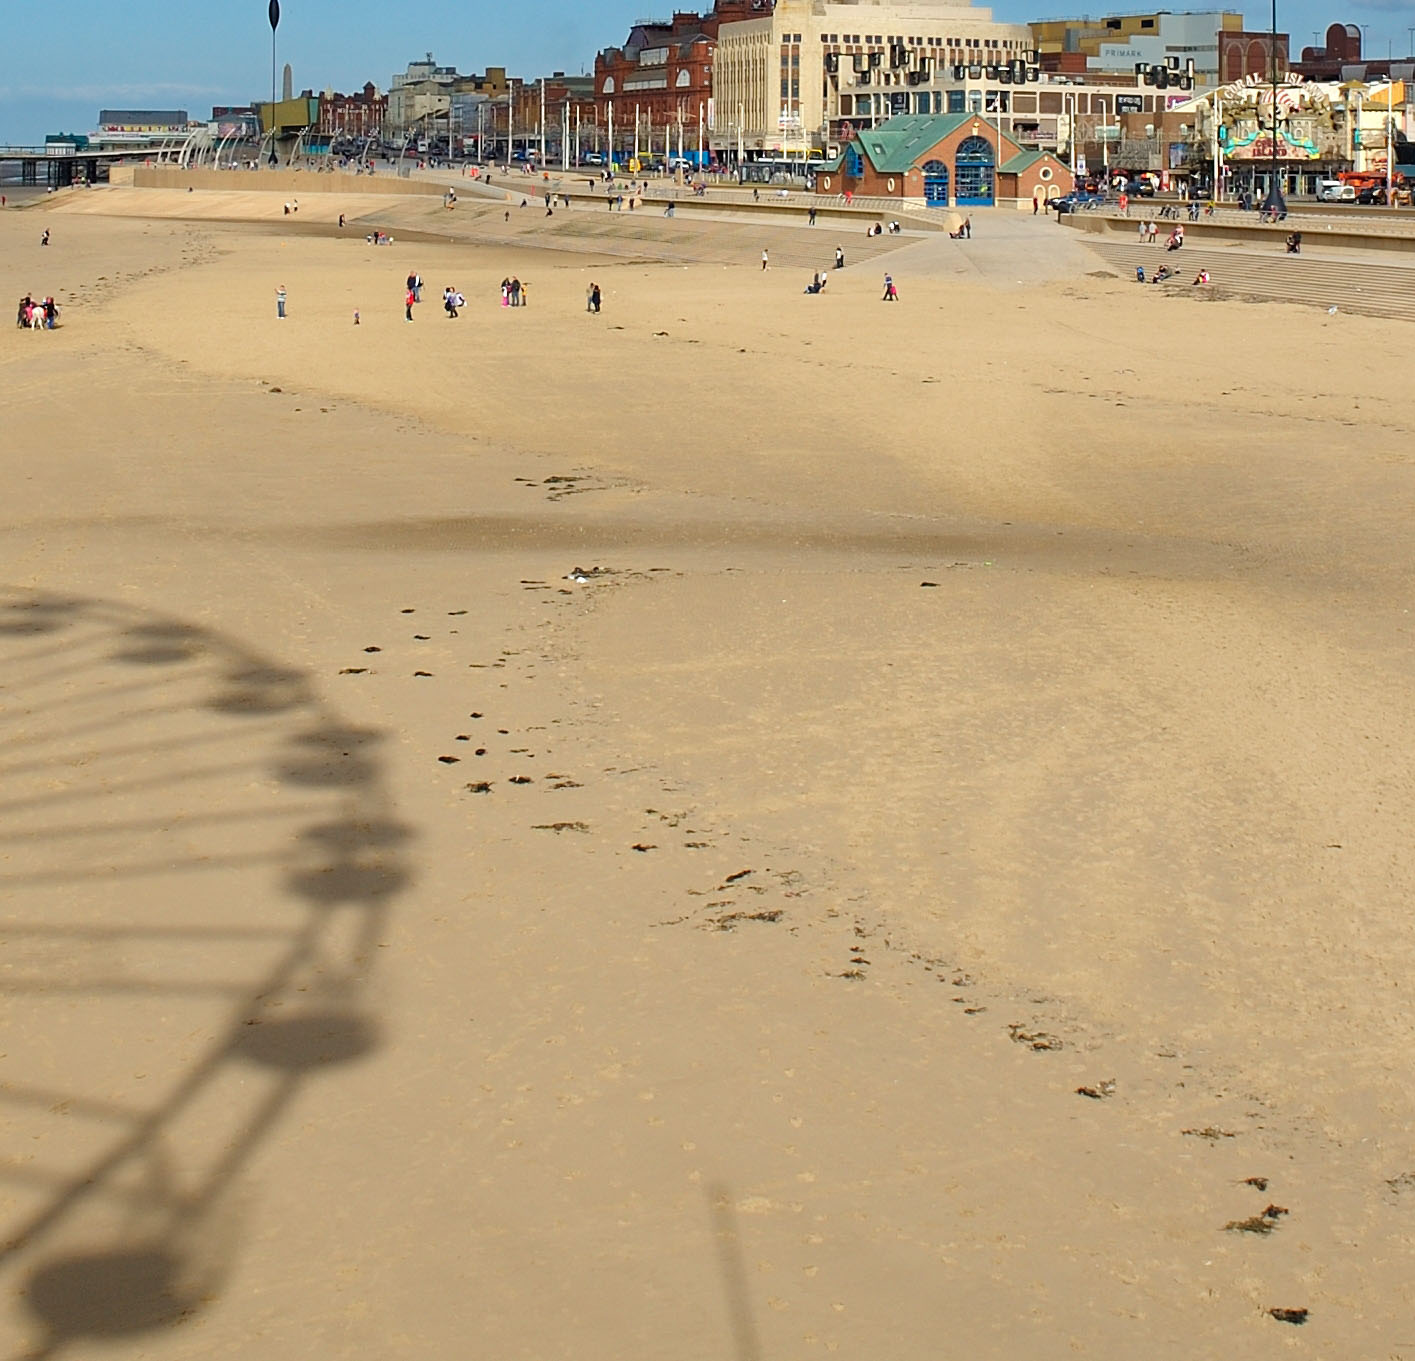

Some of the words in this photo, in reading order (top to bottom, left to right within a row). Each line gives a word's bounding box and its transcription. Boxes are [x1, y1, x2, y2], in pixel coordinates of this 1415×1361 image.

[1105, 49, 1142, 57] PRIMARK
[1224, 71, 1263, 100] CORAL
[1284, 71, 1325, 103] ISLAND
[1255, 137, 1285, 148] CORL
